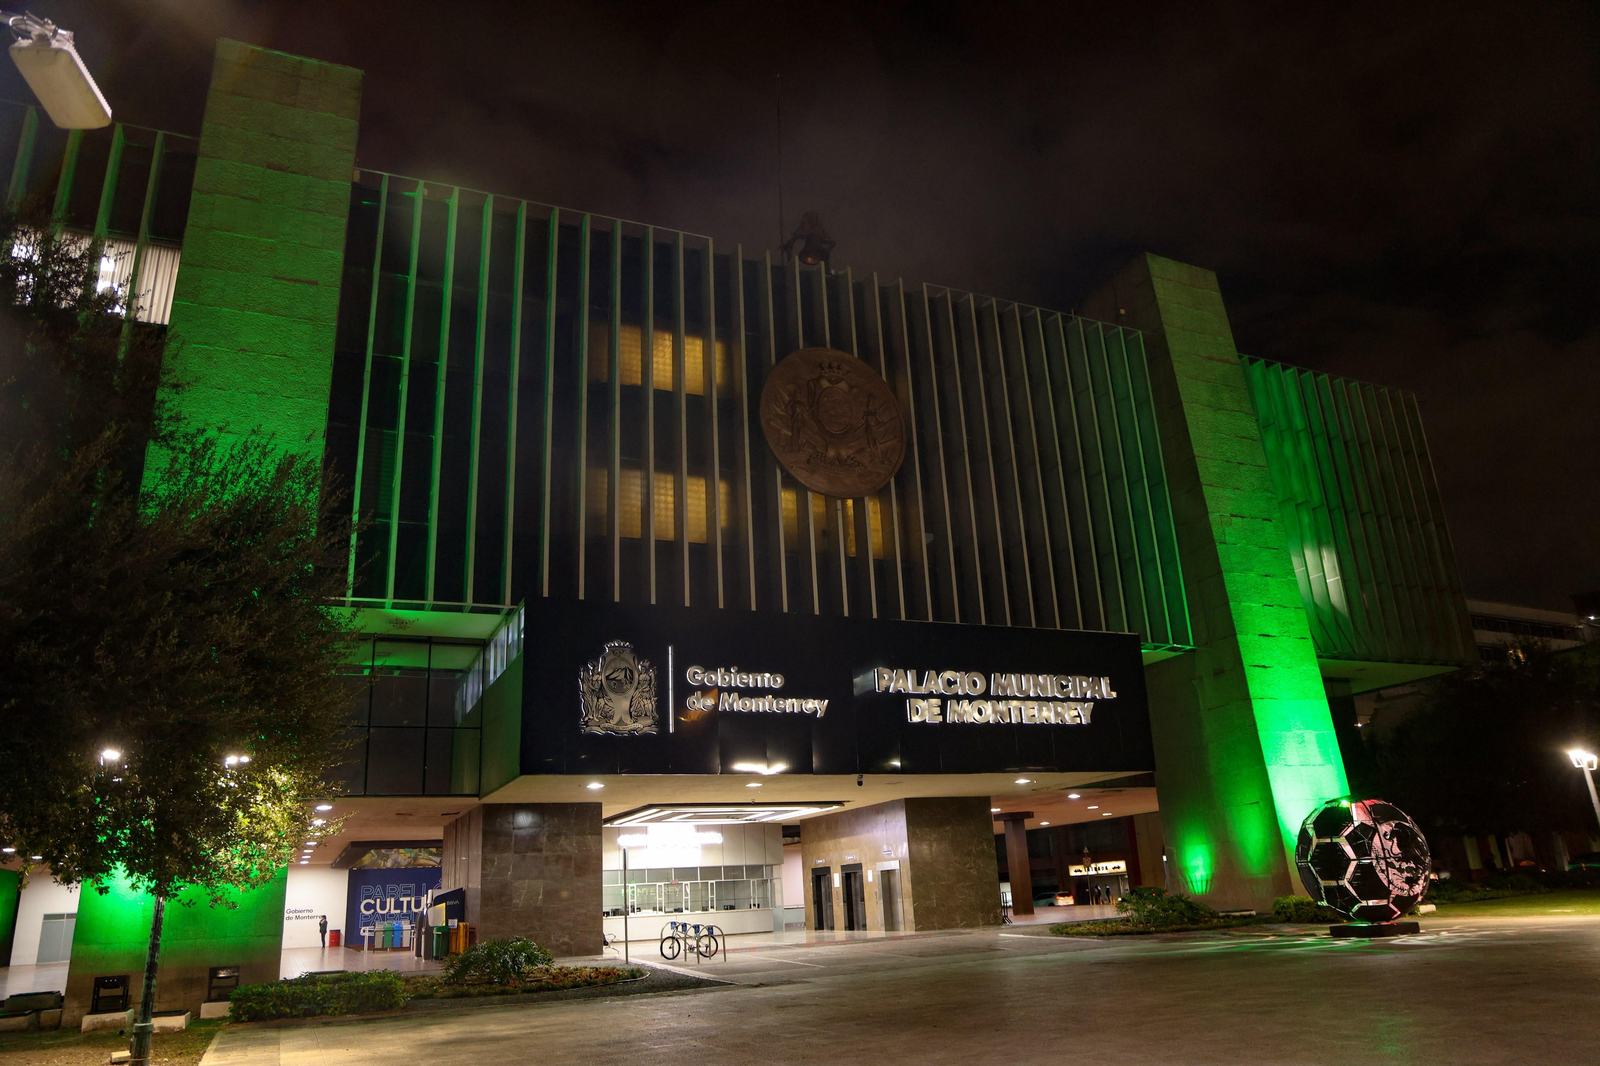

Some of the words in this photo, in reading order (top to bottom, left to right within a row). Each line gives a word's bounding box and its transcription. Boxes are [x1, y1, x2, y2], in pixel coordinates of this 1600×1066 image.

[686, 665, 785, 688] Gobierno
[874, 668, 987, 695] PALACIO
[991, 672, 1116, 699] MUNICIPAL
[686, 690, 714, 711] de
[718, 692, 829, 718] Monterrey
[907, 698, 942, 723] DE
[947, 699, 1094, 725] MONTERREY
[360, 895, 426, 915] CULTU
